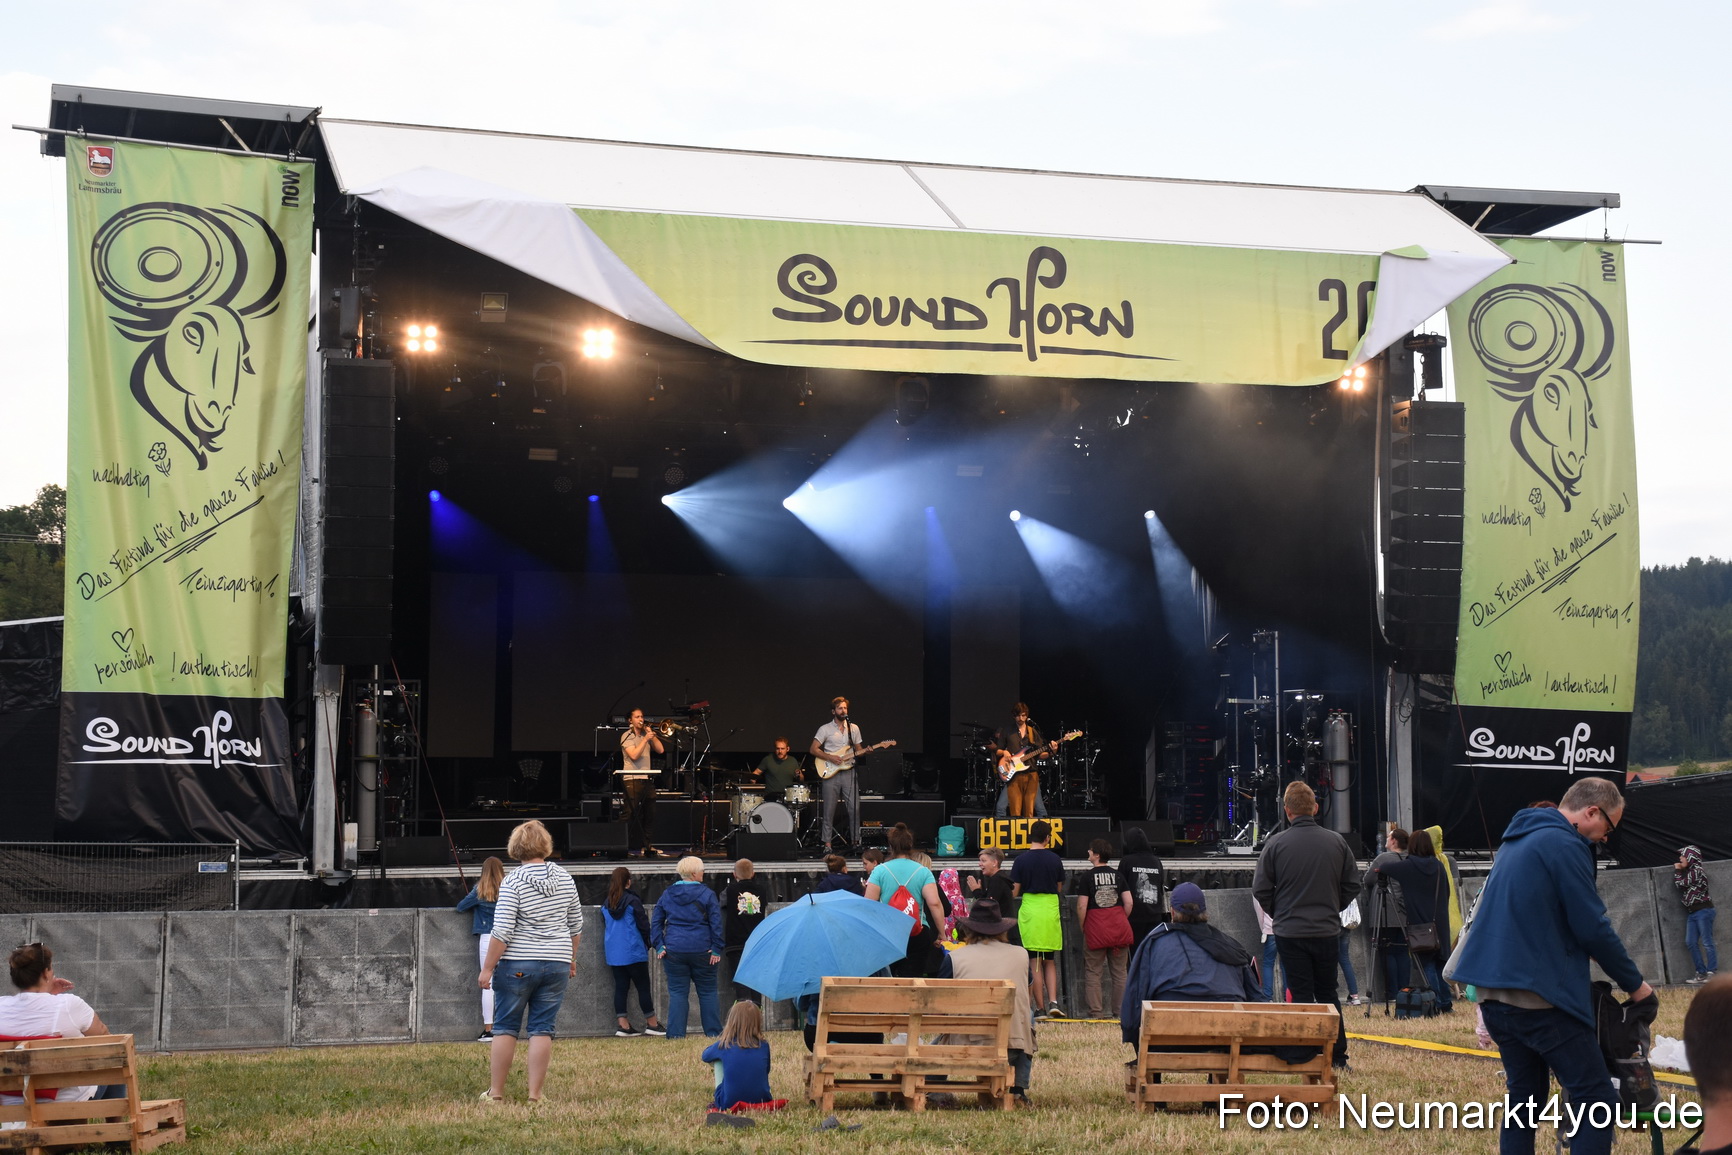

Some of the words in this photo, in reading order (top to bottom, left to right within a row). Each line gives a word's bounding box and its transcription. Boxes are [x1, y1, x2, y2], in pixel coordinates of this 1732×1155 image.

[78, 183, 122, 194] Lammsbräu
[84, 178, 117, 187] Neumarkter
[281, 169, 301, 209] now
[1600, 250, 1617, 282] now
[92, 462, 150, 498] nachhaltig
[1481, 504, 1532, 536] nachhaltig
[77, 571, 112, 601] Das
[109, 536, 155, 575] Festival
[153, 523, 176, 549] für
[180, 510, 199, 533] die
[203, 488, 237, 524] ganze
[1469, 602, 1496, 627] Das
[1494, 569, 1536, 606] Festival
[1535, 558, 1551, 581] für
[1553, 547, 1568, 566] die
[1569, 531, 1594, 559] ganze
[94, 644, 155, 685] persönlich
[1480, 663, 1532, 699] persönlich
[1093, 872, 1116, 886] FURY
